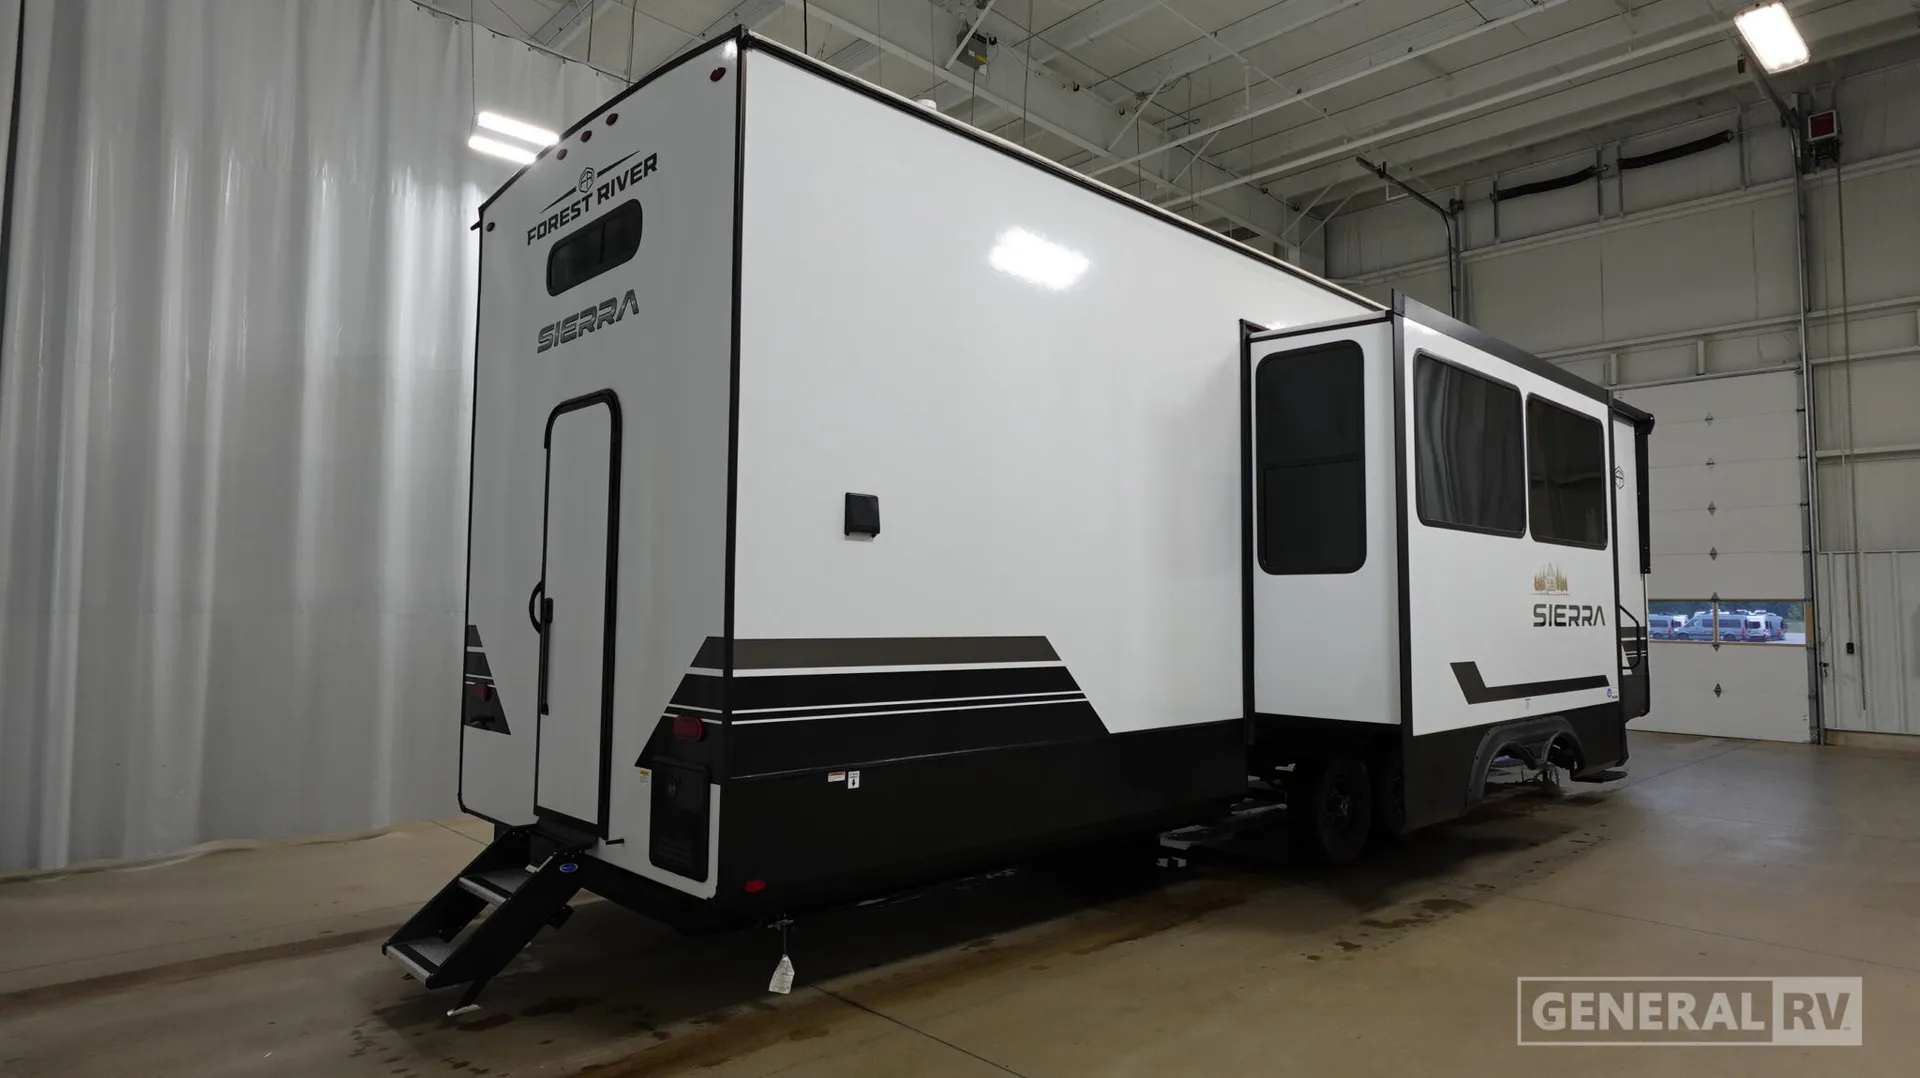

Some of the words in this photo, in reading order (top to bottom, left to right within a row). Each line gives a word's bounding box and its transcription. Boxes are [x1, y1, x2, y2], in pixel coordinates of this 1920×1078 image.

[527, 192, 593, 246] FOREST
[597, 152, 658, 205] RIVER
[537, 288, 640, 354] SIERRA
[1533, 603, 1606, 627] SIERRA
